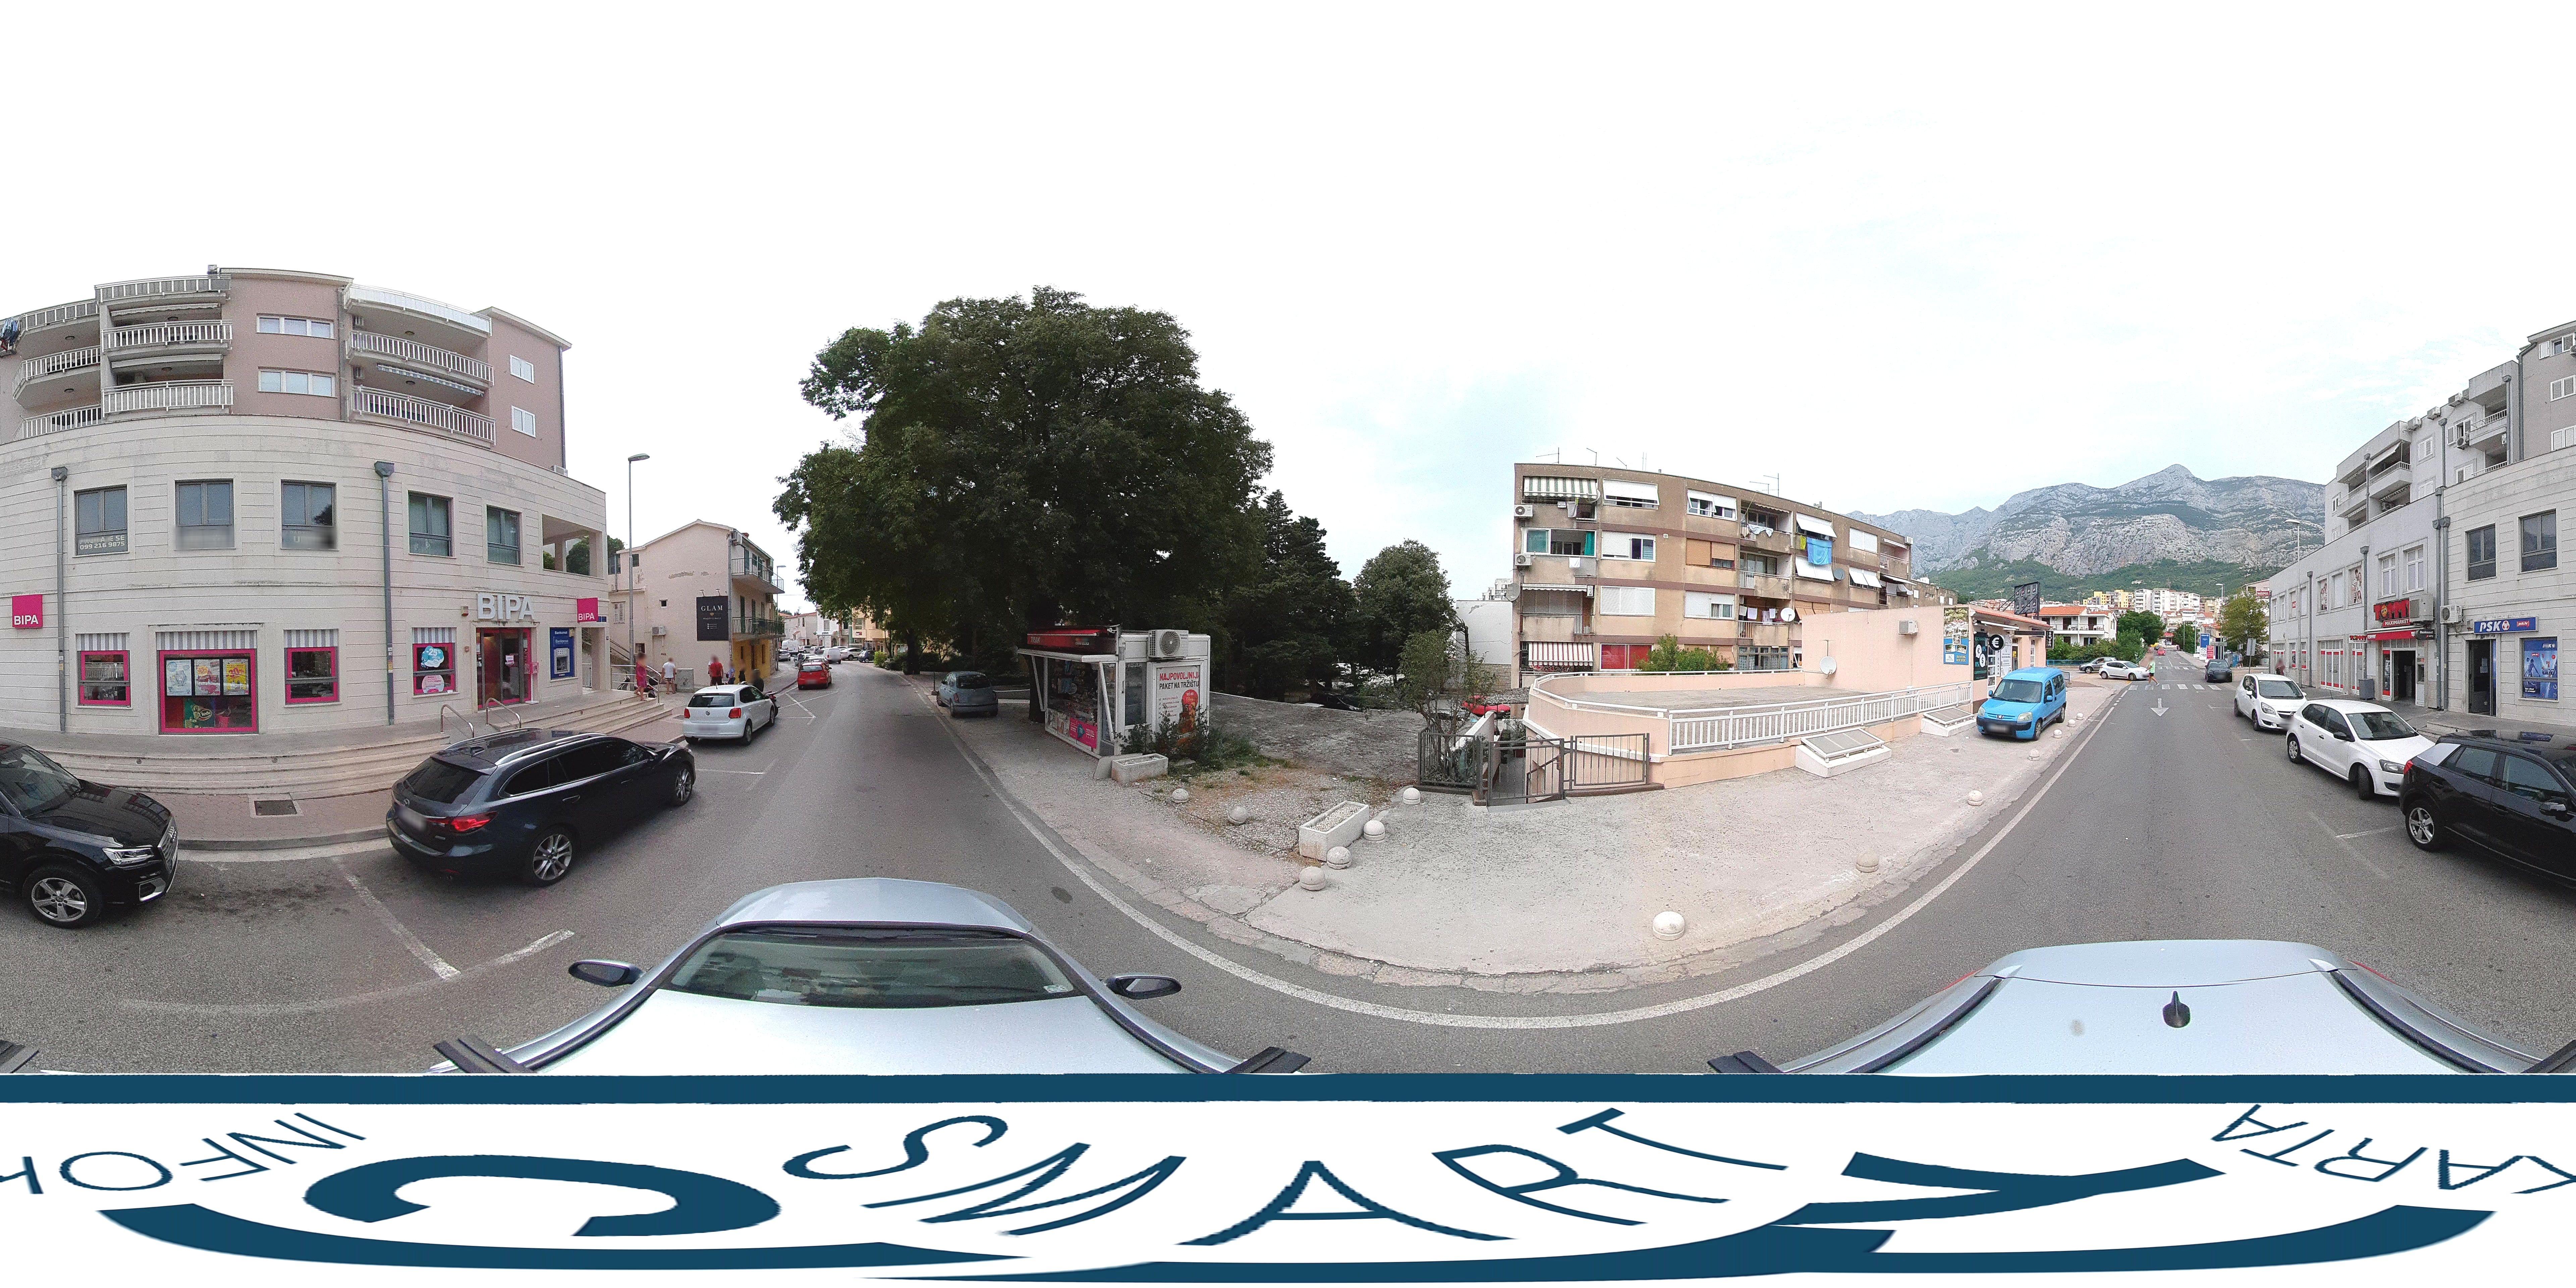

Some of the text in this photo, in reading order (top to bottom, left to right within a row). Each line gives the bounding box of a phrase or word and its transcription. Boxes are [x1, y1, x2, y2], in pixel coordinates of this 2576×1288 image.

[477, 593, 534, 620] BIPA
[14, 614, 39, 625] BIPA
[578, 613, 595, 621] BIPA
[2479, 621, 2501, 632] PSK
[1181, 680, 1199, 688] TRŽIŠTU
